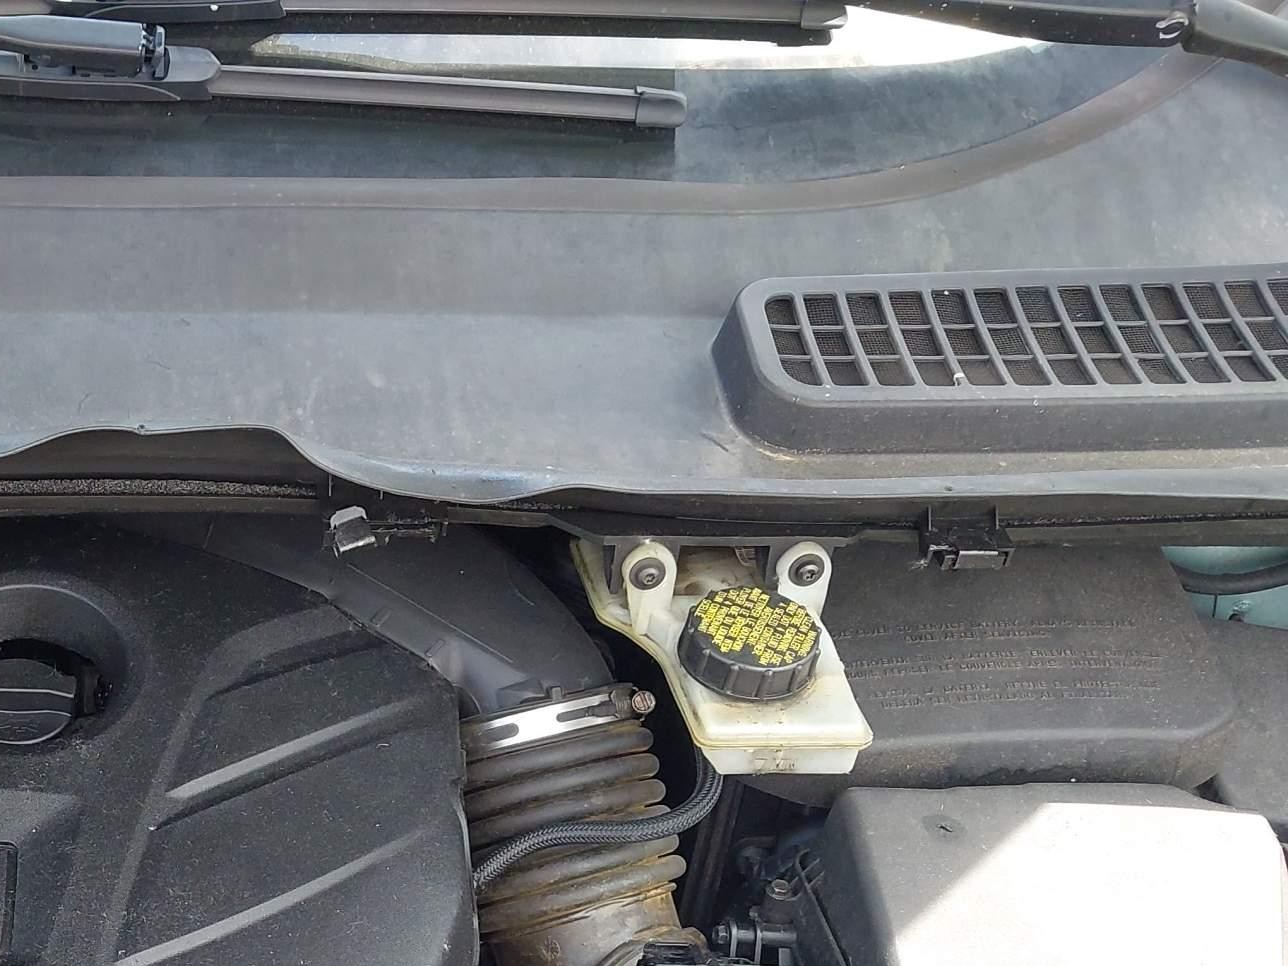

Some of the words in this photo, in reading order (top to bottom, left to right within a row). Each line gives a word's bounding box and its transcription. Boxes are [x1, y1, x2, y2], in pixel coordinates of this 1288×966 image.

[744, 617, 757, 628] LE
[767, 607, 785, 627] SEALED
[779, 614, 793, 628] DOT
[767, 632, 783, 649] FLUID
[789, 633, 806, 651] FILLER
[758, 648, 775, 666] FROM
[769, 653, 784, 666] USE
[782, 650, 796, 665] CAP
